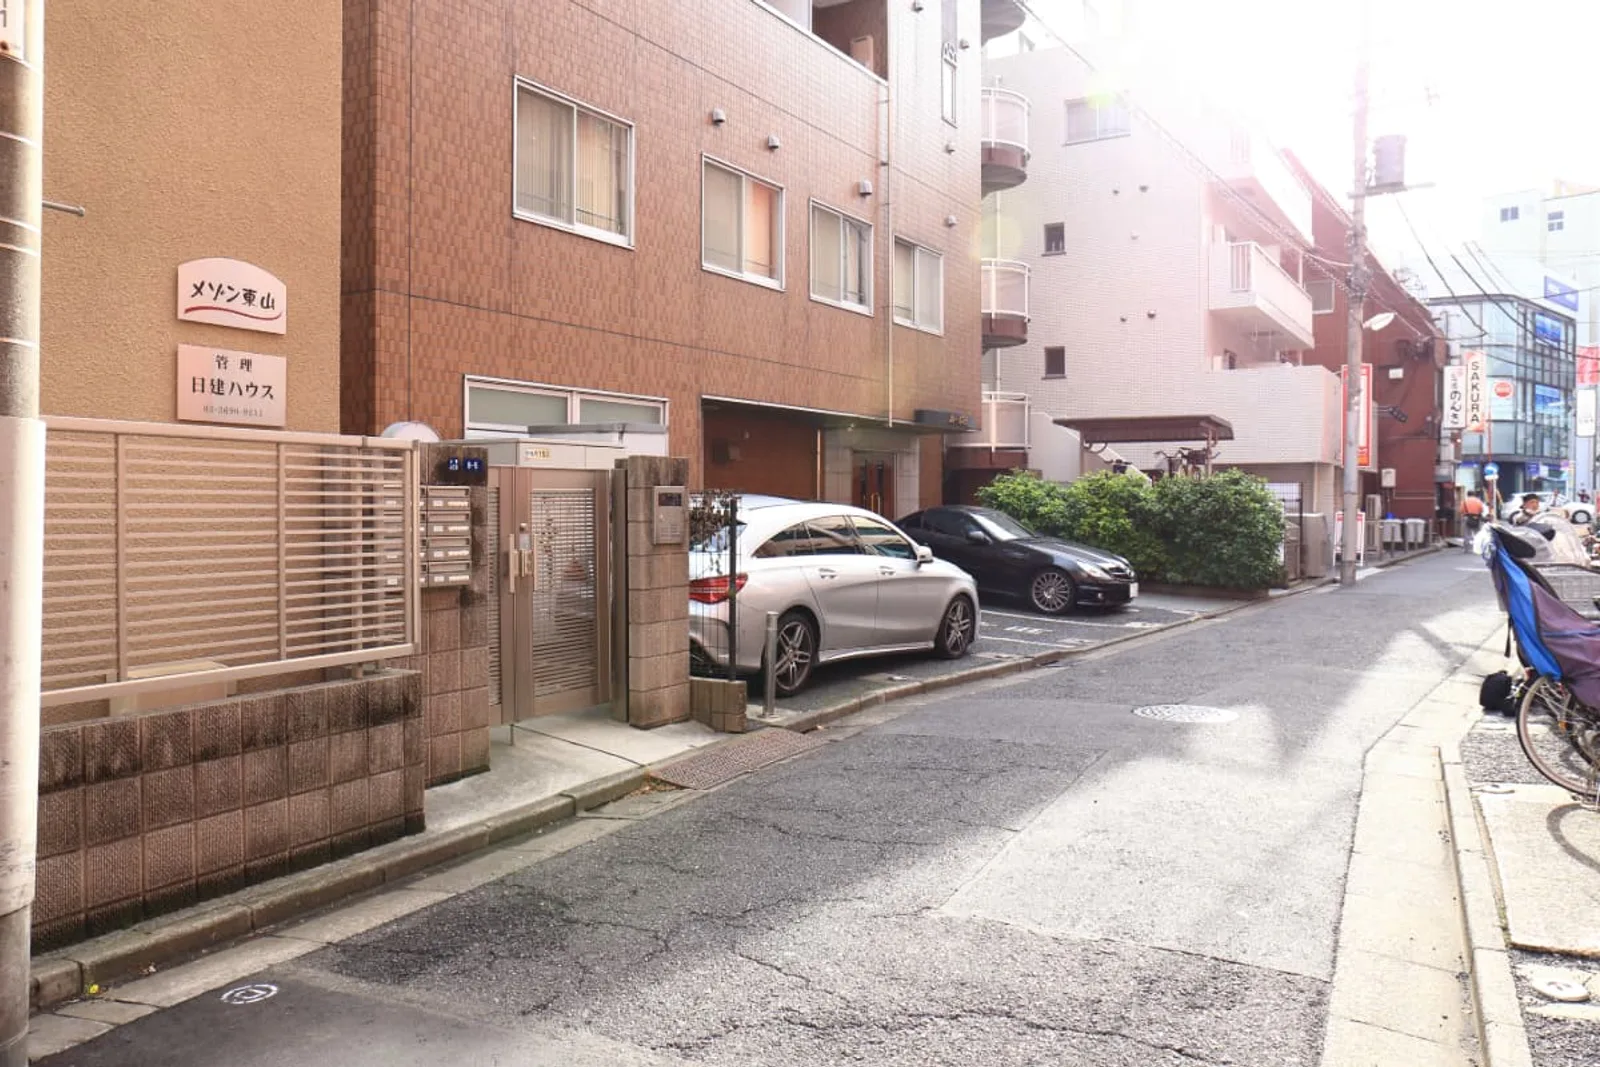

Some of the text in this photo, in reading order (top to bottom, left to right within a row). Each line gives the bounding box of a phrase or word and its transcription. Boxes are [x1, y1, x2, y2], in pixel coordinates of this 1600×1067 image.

[191, 280, 276, 311] メゾン東山
[215, 354, 253, 373] 管理
[191, 376, 274, 400] 日建ハウス
[1471, 361, 1480, 423] SAKURA
